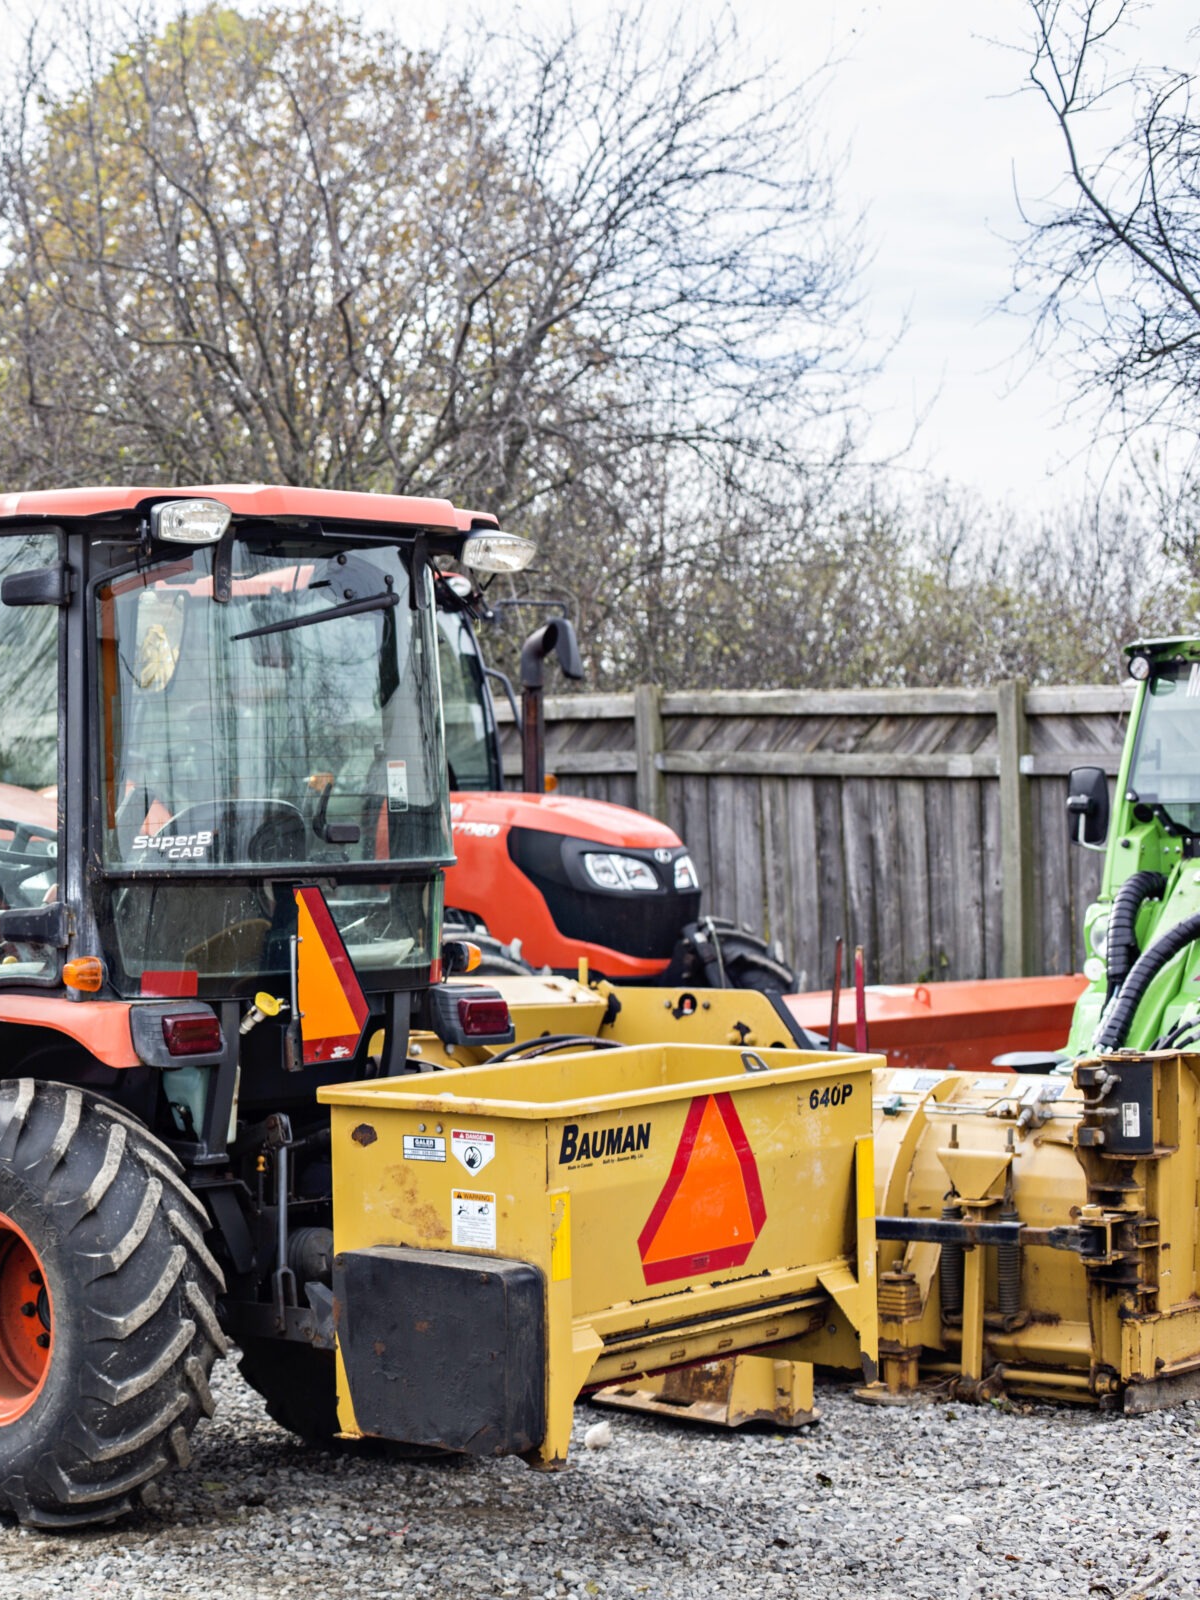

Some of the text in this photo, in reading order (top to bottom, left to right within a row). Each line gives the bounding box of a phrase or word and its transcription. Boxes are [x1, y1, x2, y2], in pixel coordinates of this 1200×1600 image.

[131, 831, 213, 851] SuperB
[168, 846, 205, 859] CAB
[809, 1082, 854, 1110] 640P
